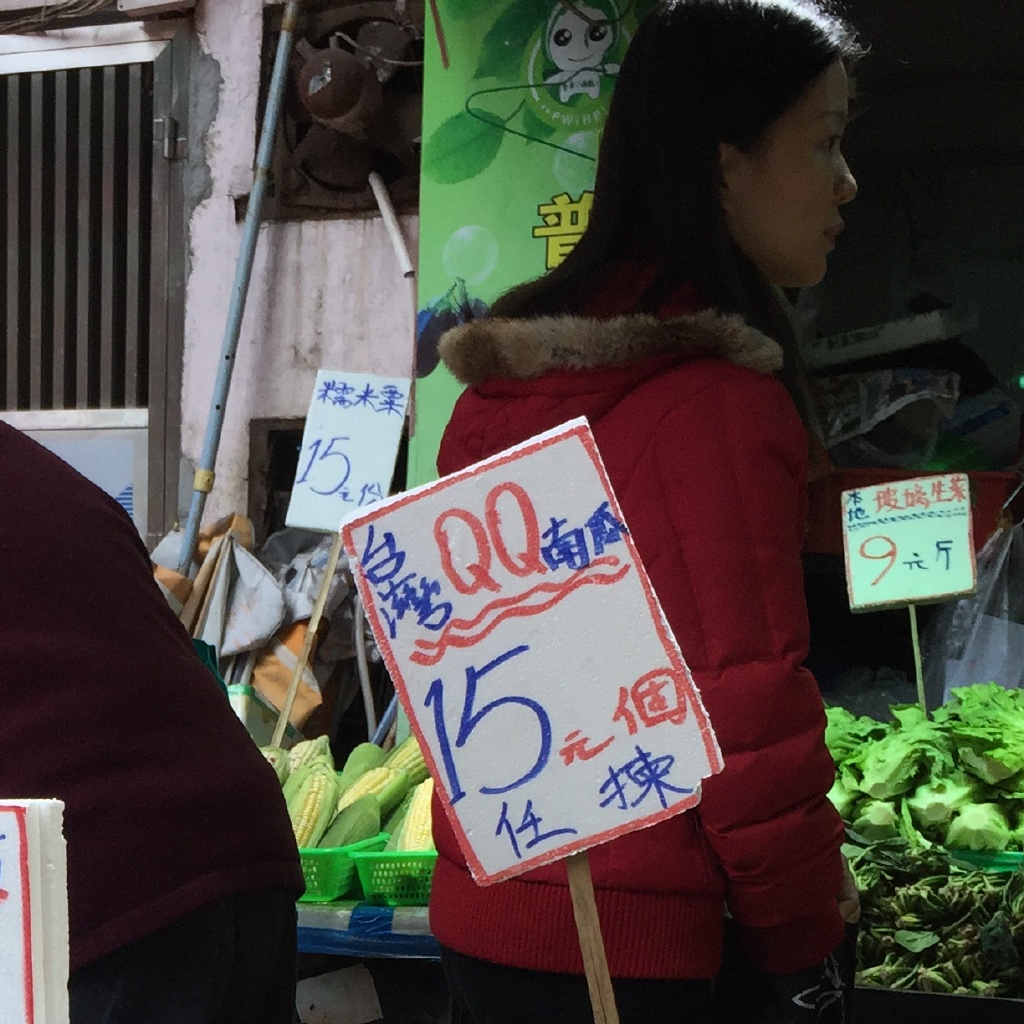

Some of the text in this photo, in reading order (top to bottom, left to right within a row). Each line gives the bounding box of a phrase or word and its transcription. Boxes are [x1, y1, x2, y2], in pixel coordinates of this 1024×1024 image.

[296, 436, 351, 496] 15
[433, 481, 547, 597] QQ
[859, 535, 897, 586] 9
[423, 645, 553, 806] 15
